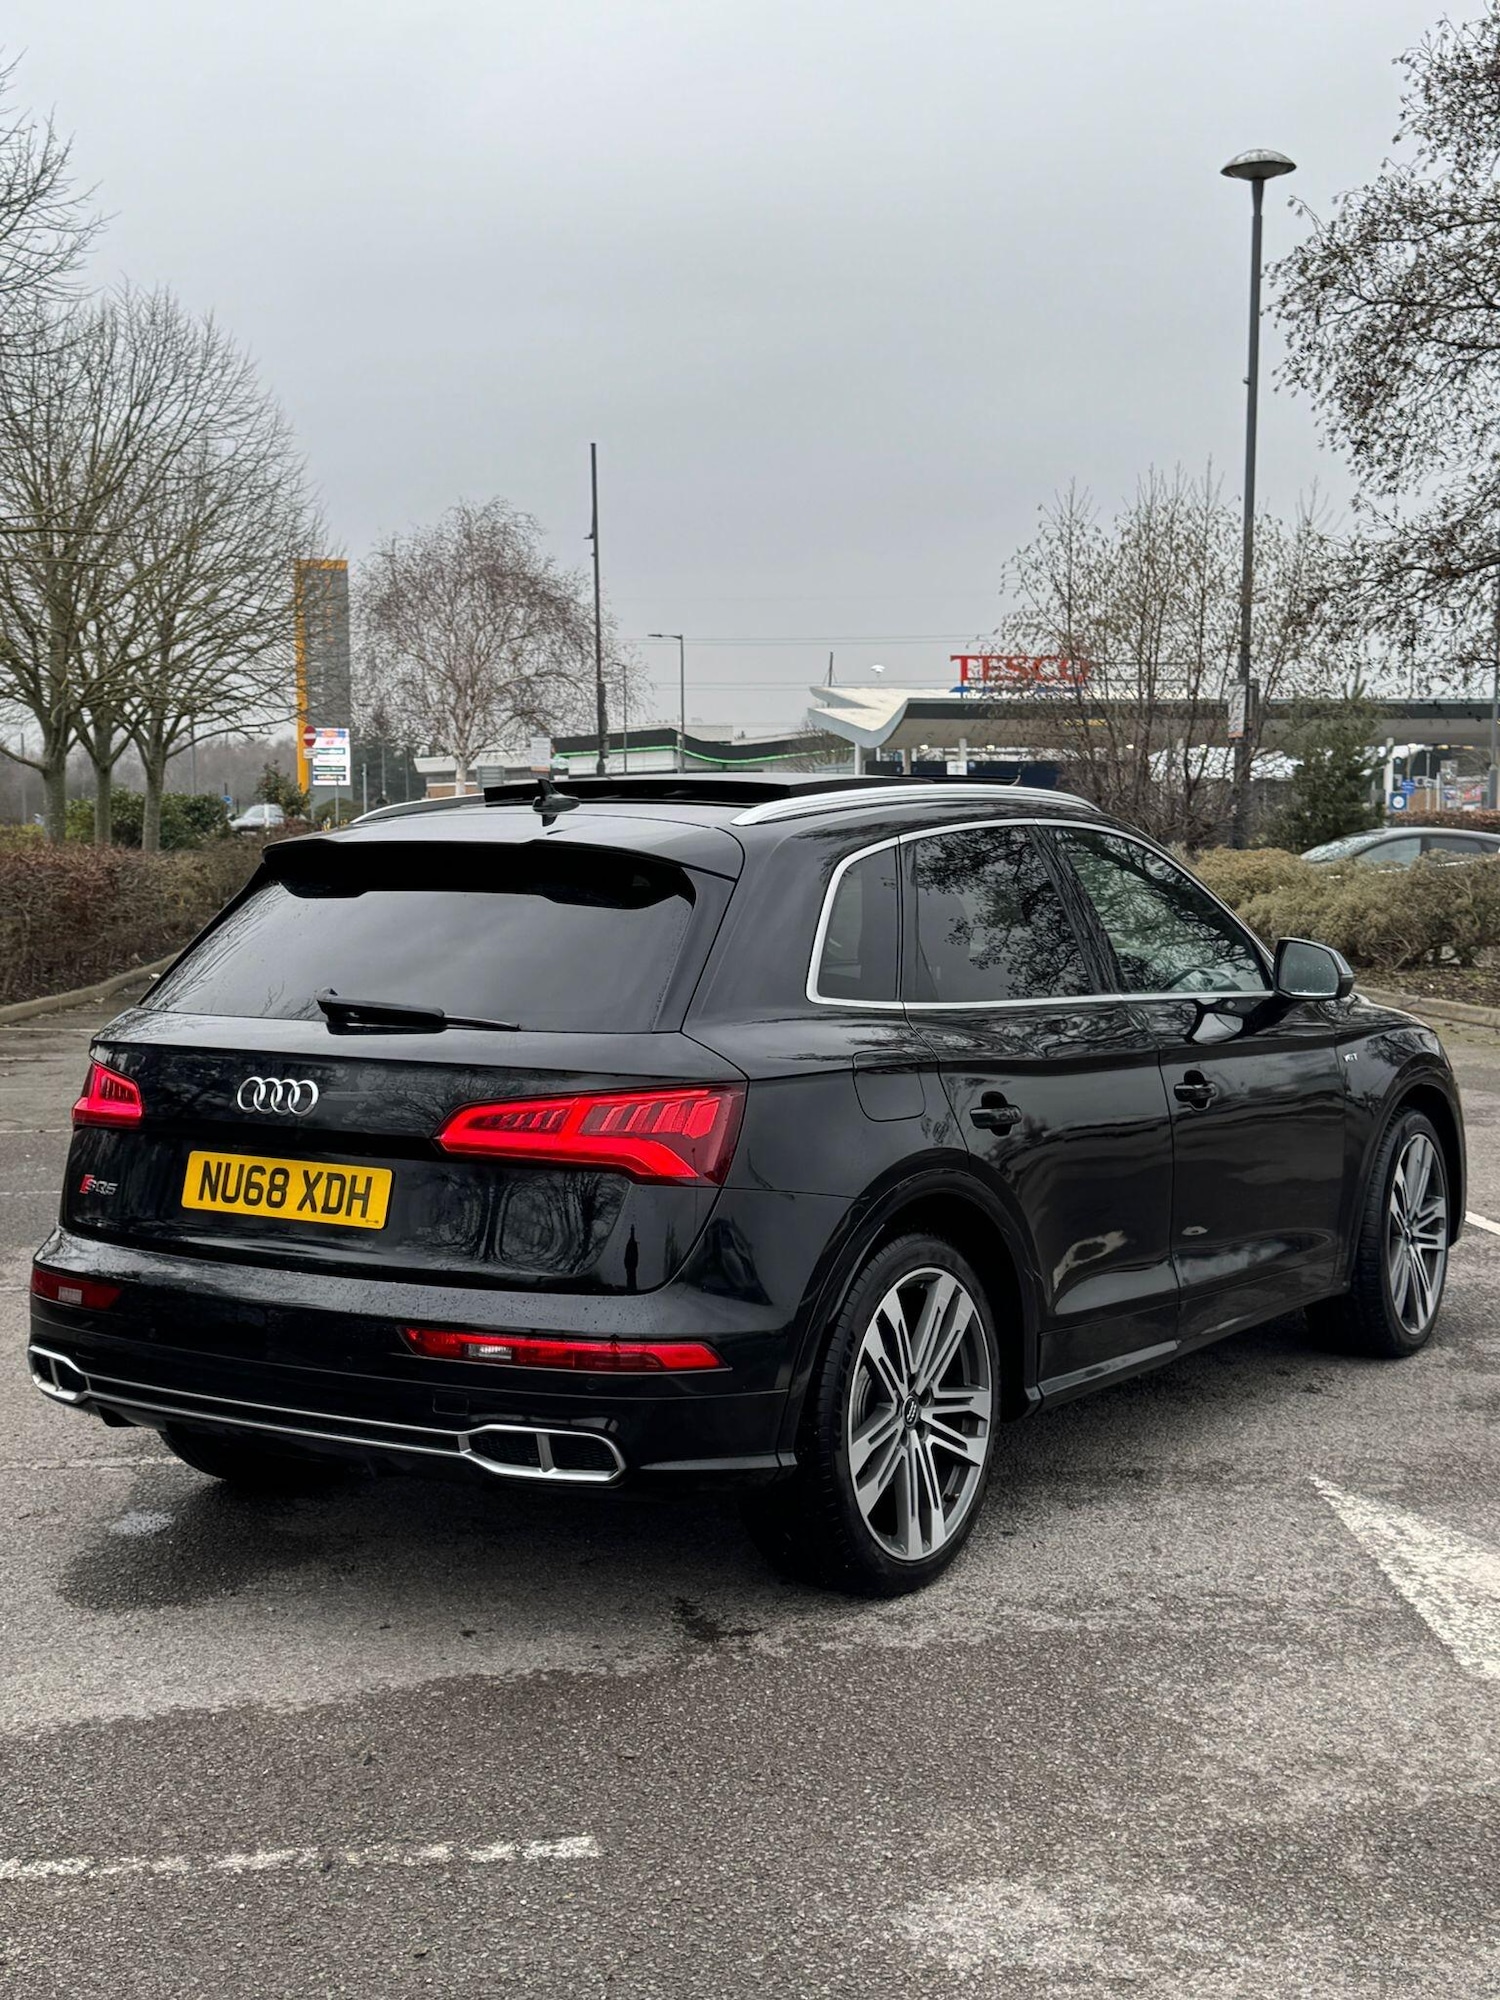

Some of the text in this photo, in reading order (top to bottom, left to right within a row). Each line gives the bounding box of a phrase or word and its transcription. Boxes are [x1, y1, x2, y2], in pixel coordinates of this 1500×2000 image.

[950, 655, 1088, 683] TESCO
[79, 1174, 119, 1195] SQ5
[198, 1160, 373, 1218] NU68 XDH
